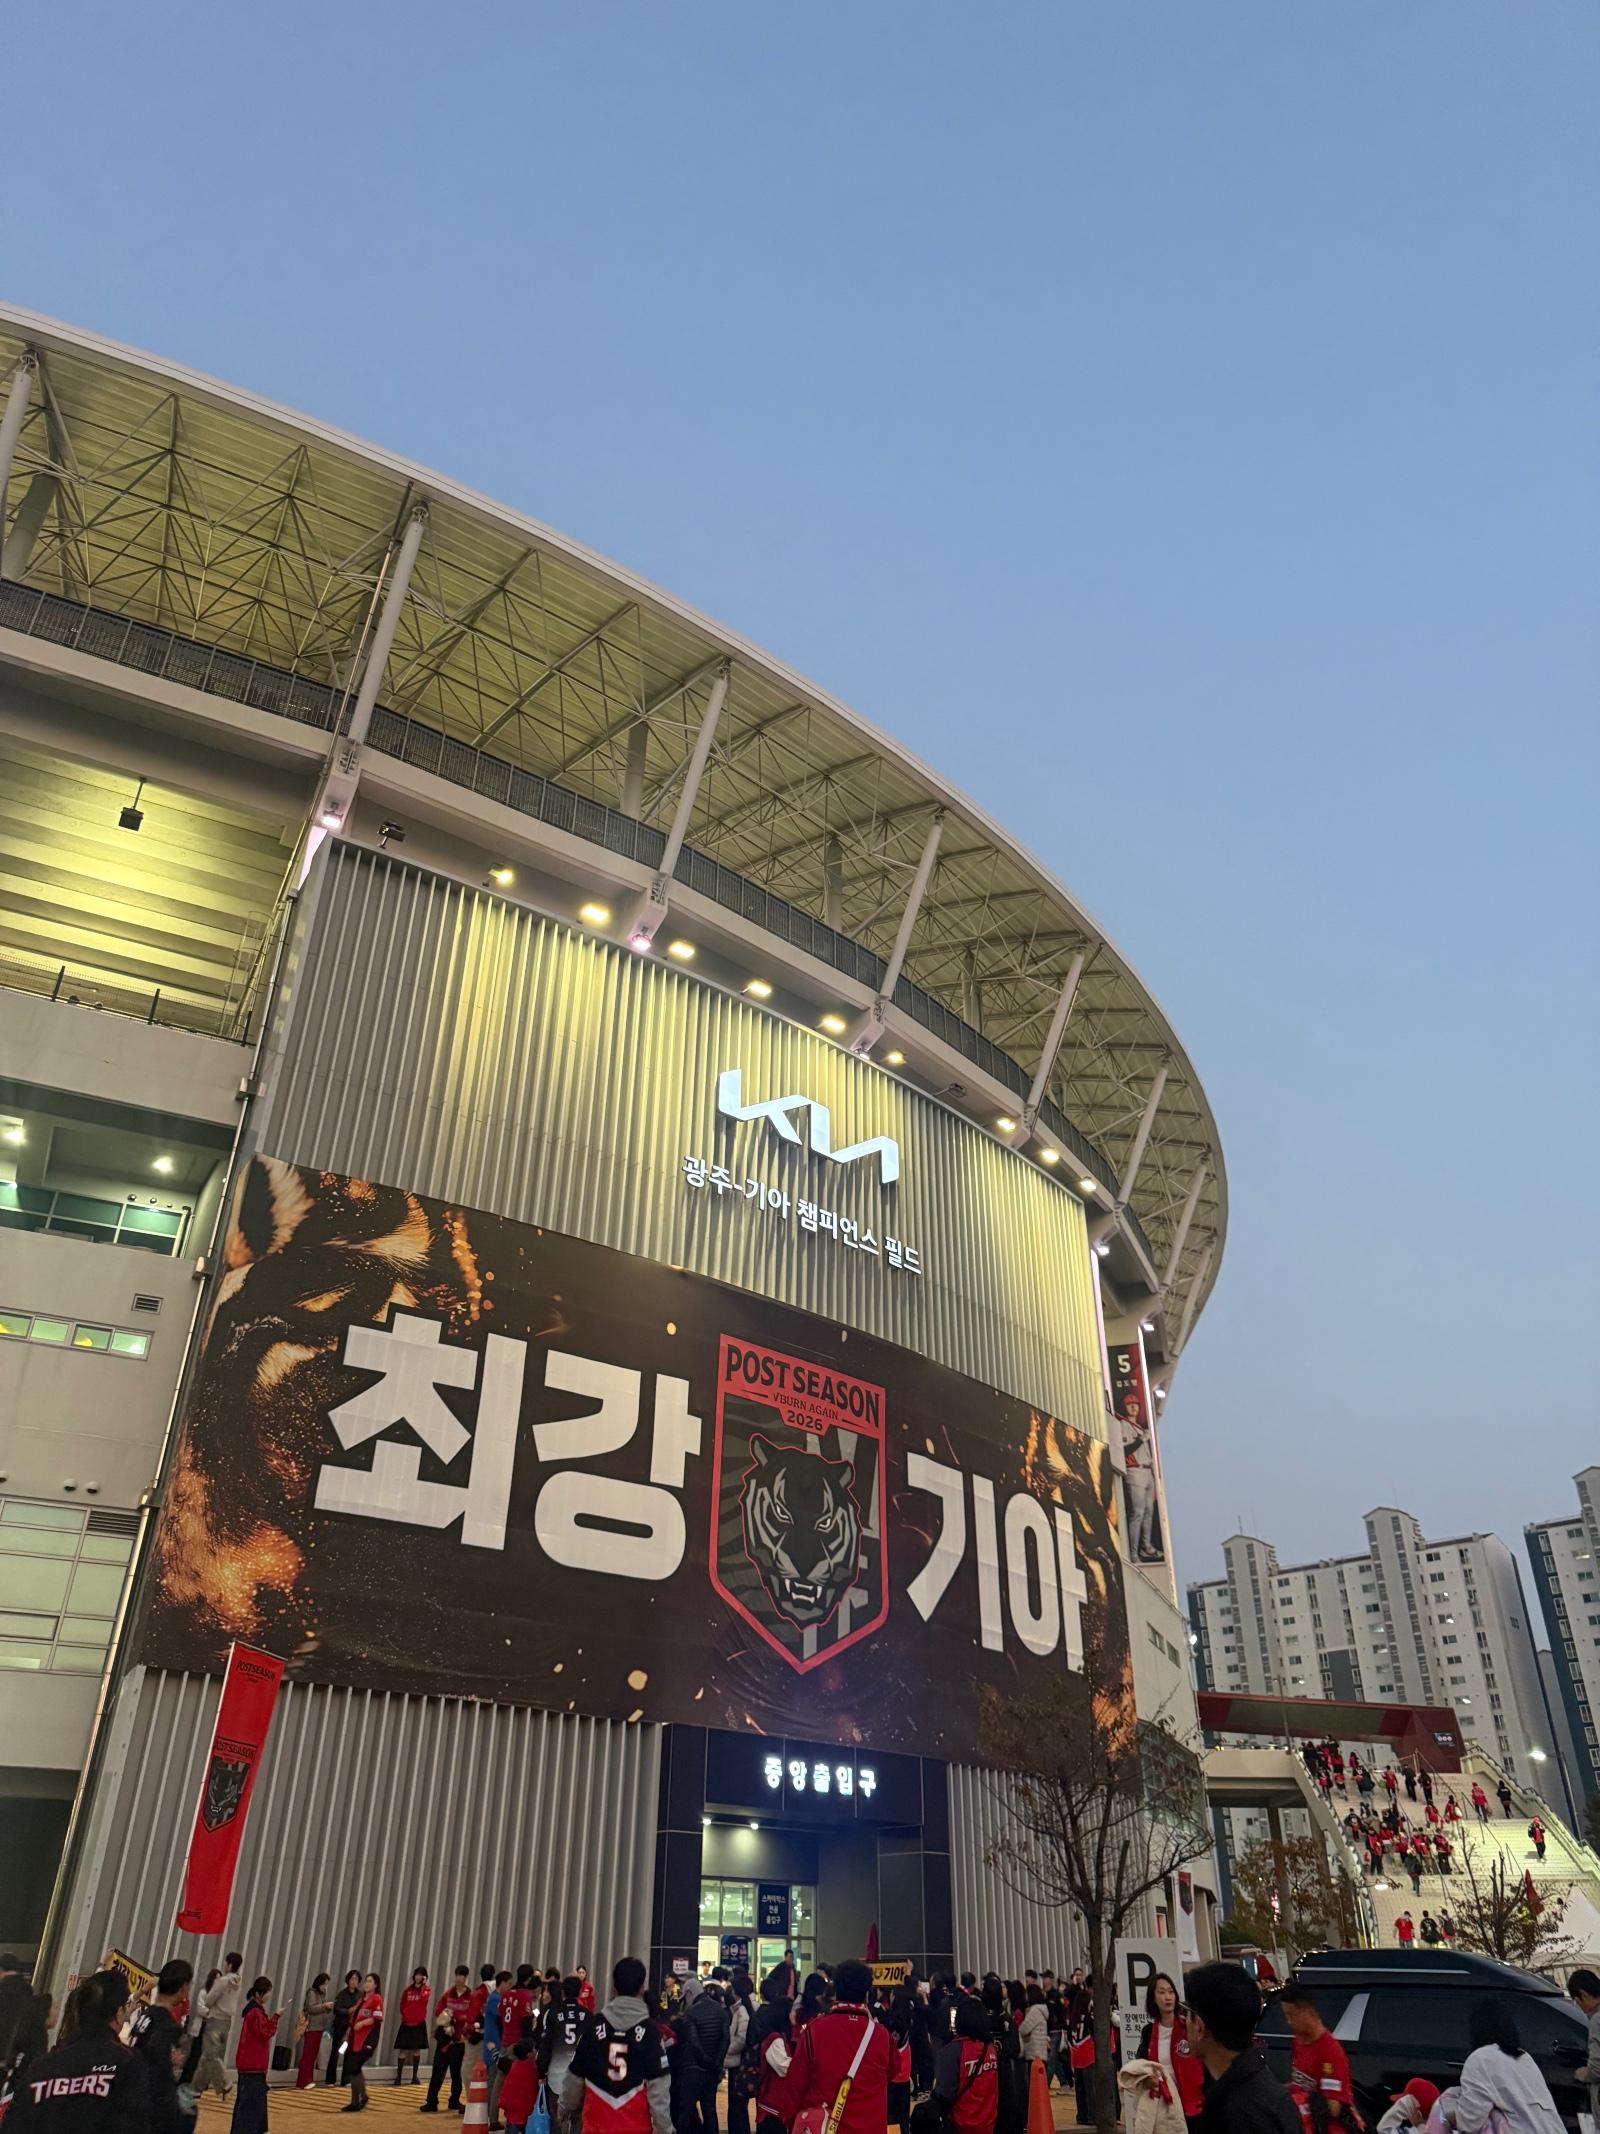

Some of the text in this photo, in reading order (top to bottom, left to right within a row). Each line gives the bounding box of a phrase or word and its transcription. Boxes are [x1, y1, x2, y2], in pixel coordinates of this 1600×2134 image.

[719, 1068, 900, 1184] KIA
[683, 1155, 922, 1275] 광주-기아 챔피언스 필드
[1117, 1354, 1131, 1374] 5
[787, 1410, 823, 1432] 2026
[808, 1403, 839, 1421] AGAIN
[314, 1312, 1089, 1676] 최강 기아
[764, 1756, 877, 1798] 중앙출입구
[1126, 1952, 1157, 2007] P
[504, 2006, 512, 2023] 8
[564, 2023, 577, 2045] 5
[92, 2064, 118, 2073] KIA
[607, 2042, 629, 2082] 5
[30, 2074, 116, 2104] TIGERS
